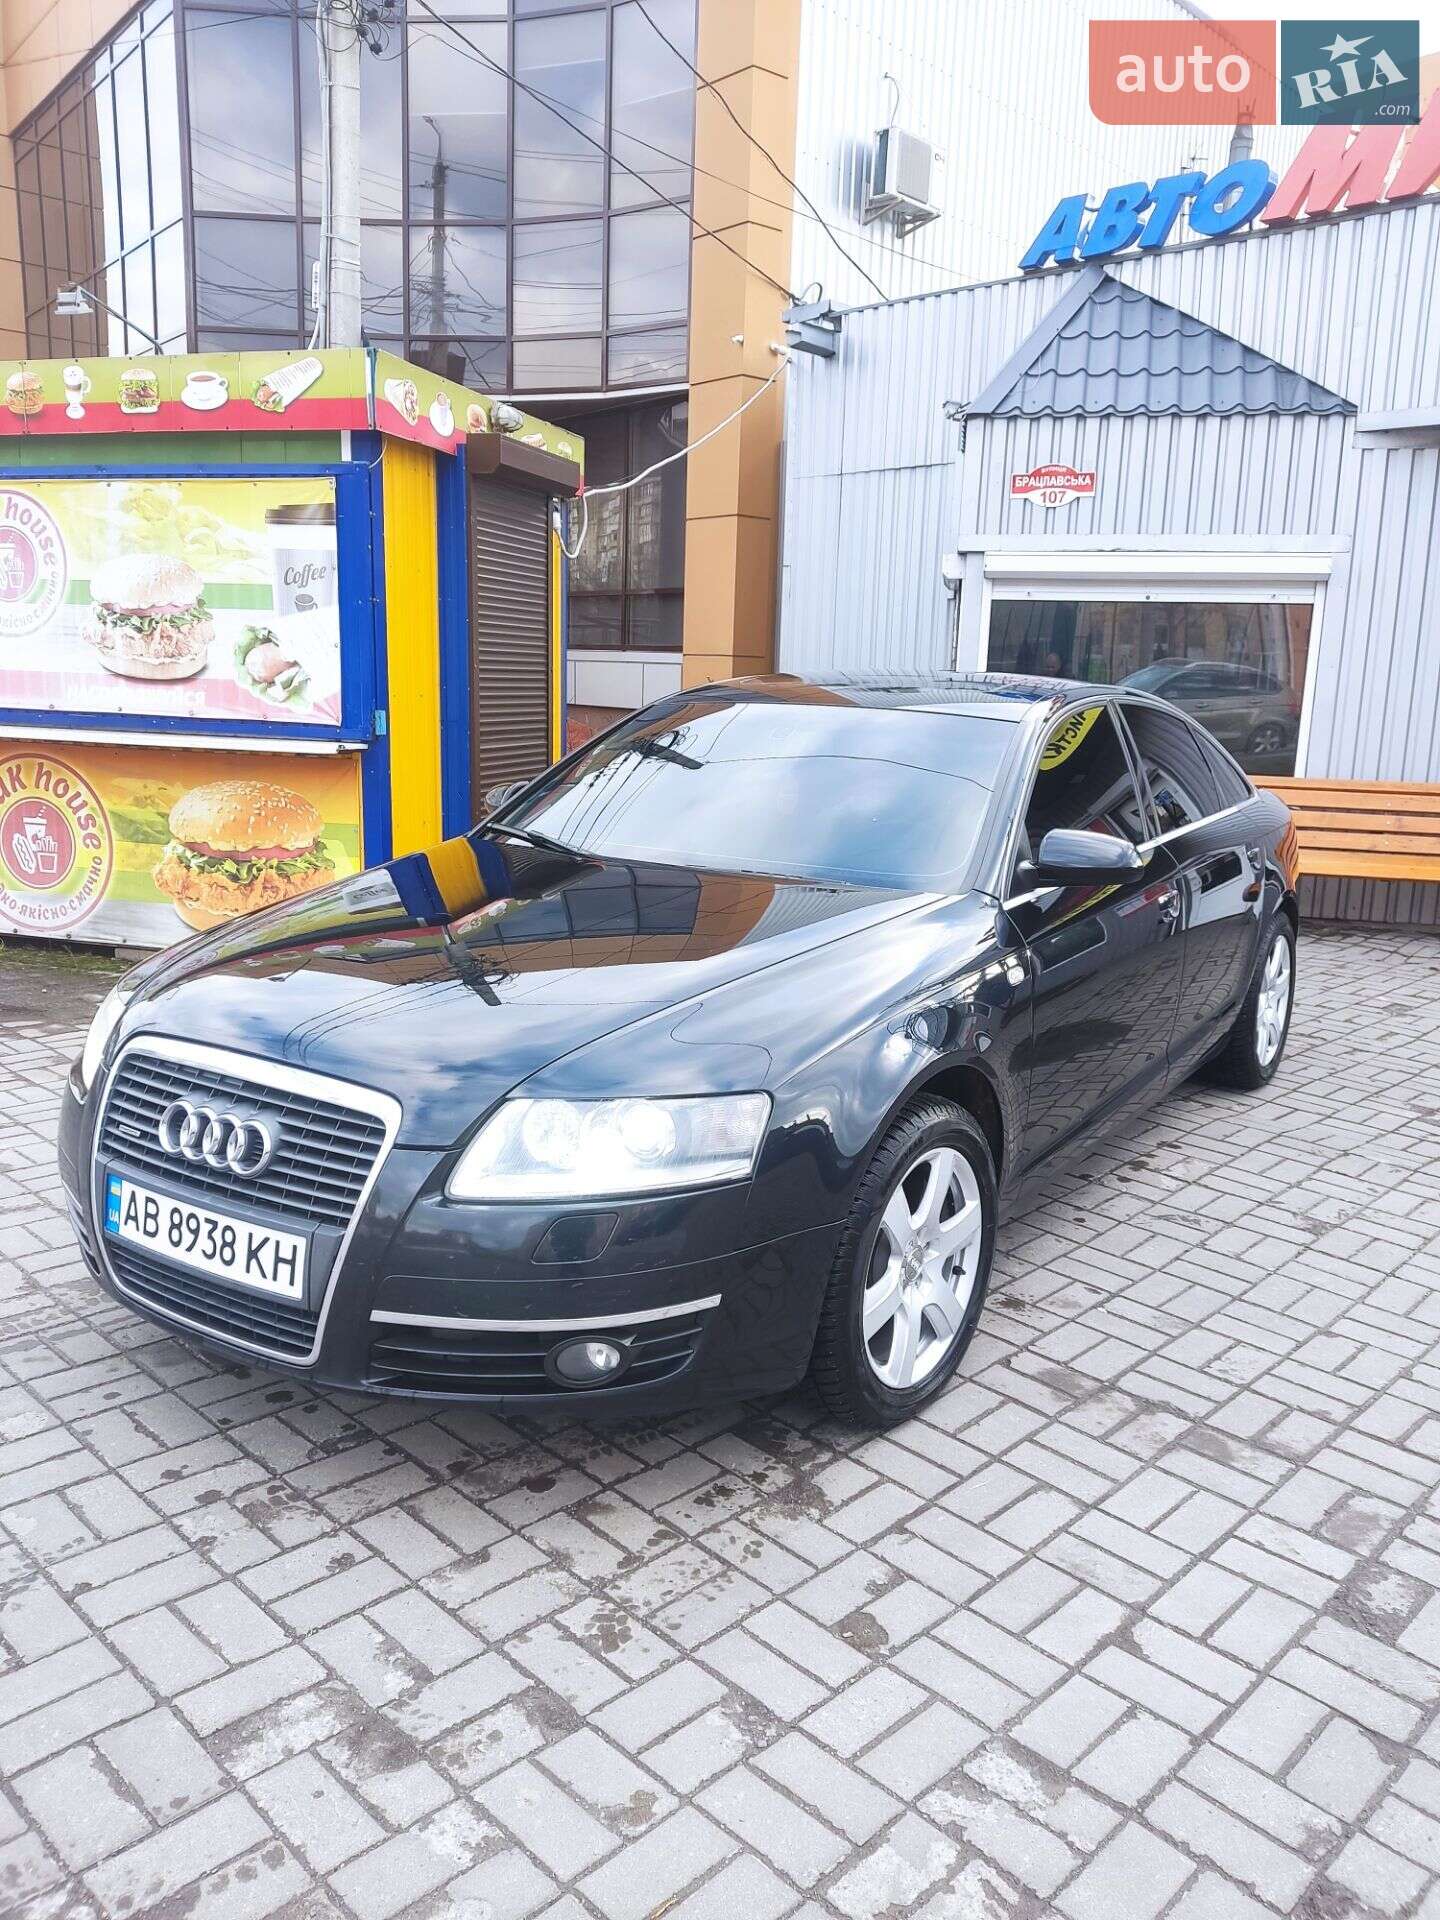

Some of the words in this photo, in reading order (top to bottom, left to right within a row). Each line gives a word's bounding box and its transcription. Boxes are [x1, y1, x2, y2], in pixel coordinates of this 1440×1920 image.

[1015, 474, 1092, 489] БРАЦЛАВСЬКА
[1040, 490, 1067, 504] 107
[4, 496, 58, 567] house
[283, 563, 327, 588] Coffee
[34, 761, 102, 850] house
[109, 1207, 120, 1224] UA
[124, 1189, 160, 1239] AB
[168, 1206, 237, 1267] 8938
[245, 1231, 298, 1287] KH
